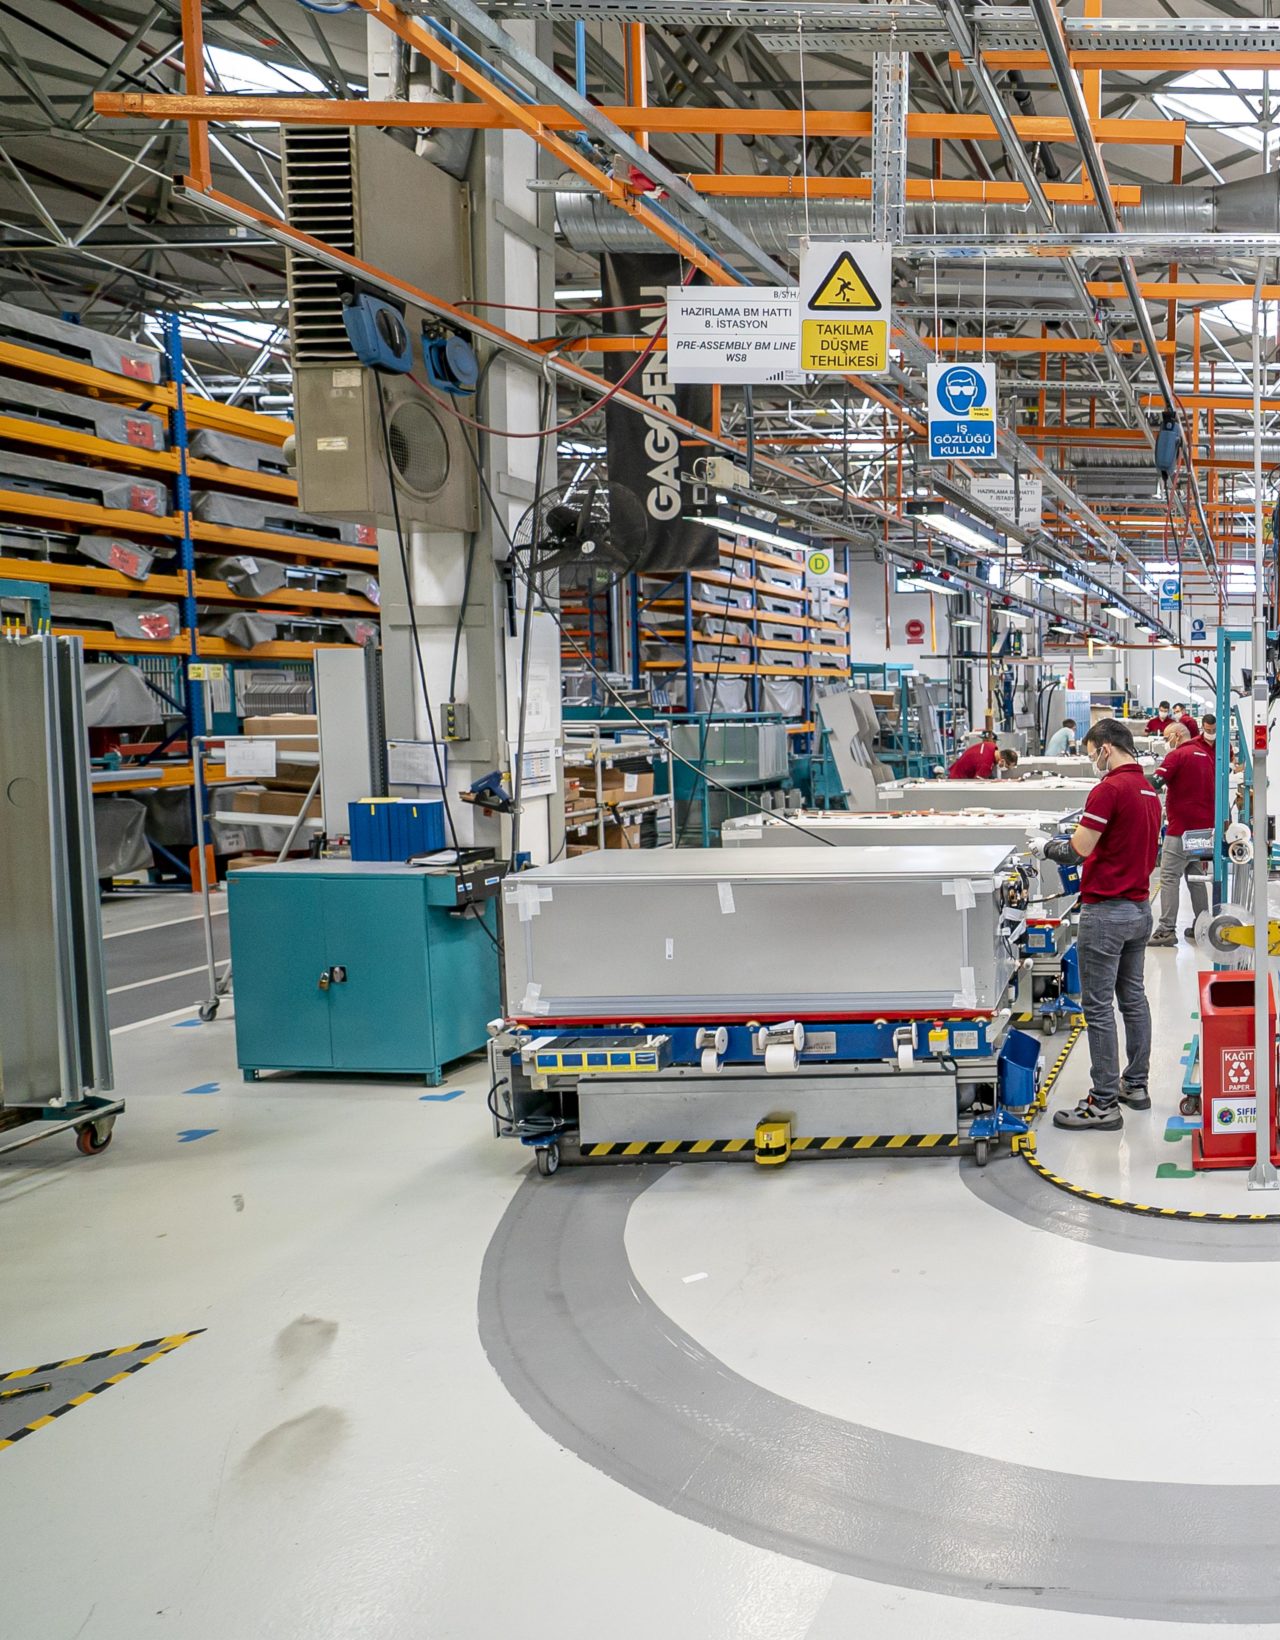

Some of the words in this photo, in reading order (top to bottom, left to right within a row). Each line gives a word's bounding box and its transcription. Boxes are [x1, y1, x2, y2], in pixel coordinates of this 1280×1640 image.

[681, 307, 740, 317] HAZIRLAMA
[743, 308, 759, 317] BM
[762, 308, 792, 317] HATTI
[705, 320, 714, 328] 8.
[716, 318, 768, 329] İSTASYON
[816, 324, 874, 336] TAKILMA
[676, 341, 752, 350] PRE-ASSEMBLY
[754, 342, 771, 350] BM
[773, 342, 797, 351] LINE
[820, 337, 869, 353] DÜŞME
[726, 353, 747, 362] WS8
[810, 352, 879, 367] TEHLİKESİ
[956, 422, 968, 435] İŞ
[934, 434, 992, 444] GÖZLÜĞÜ
[940, 446, 985, 454] KULLAN
[815, 558, 824, 570] D
[1224, 1050, 1254, 1061] KAĞIT
